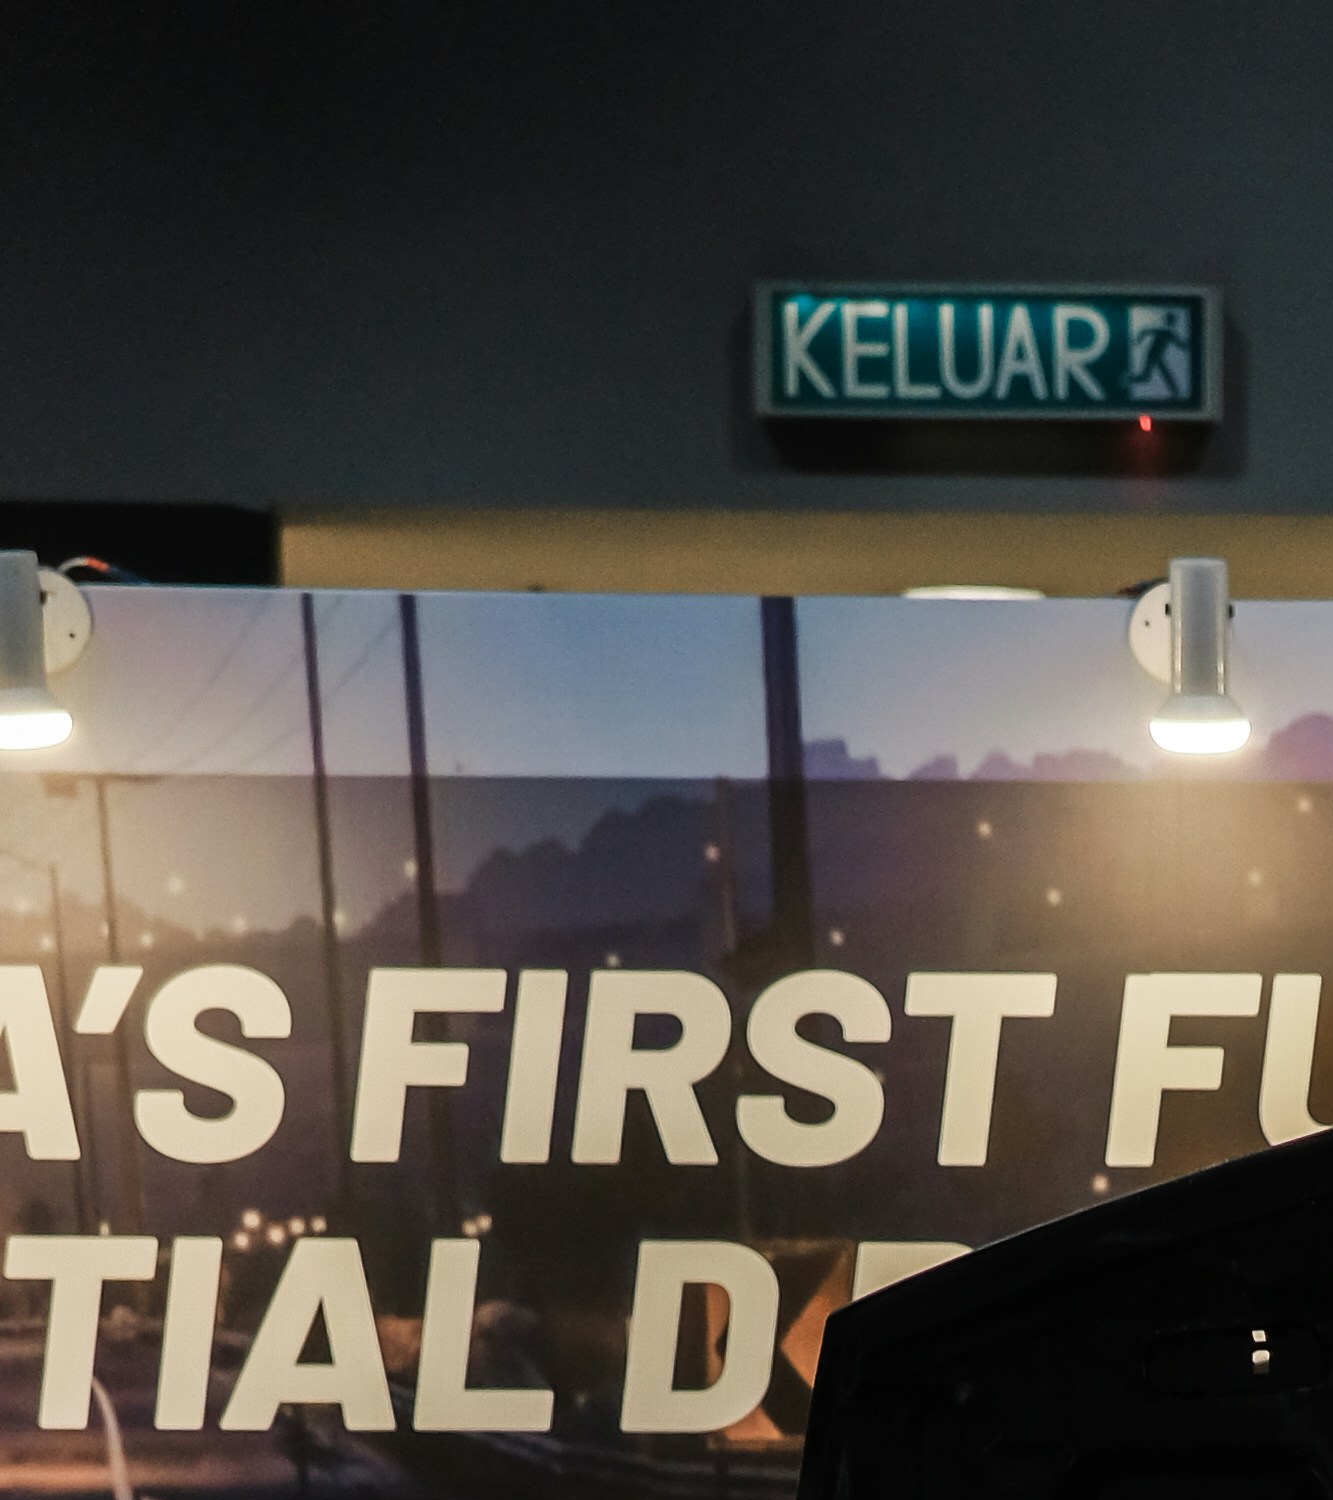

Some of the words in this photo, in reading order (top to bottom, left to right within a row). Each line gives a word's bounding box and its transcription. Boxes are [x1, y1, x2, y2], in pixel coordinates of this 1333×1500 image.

[782, 301, 1108, 401] KELUAR
[349, 967, 1058, 1168] FIRST
[2, 1235, 555, 1433] TIAL
[619, 1239, 781, 1434] D
